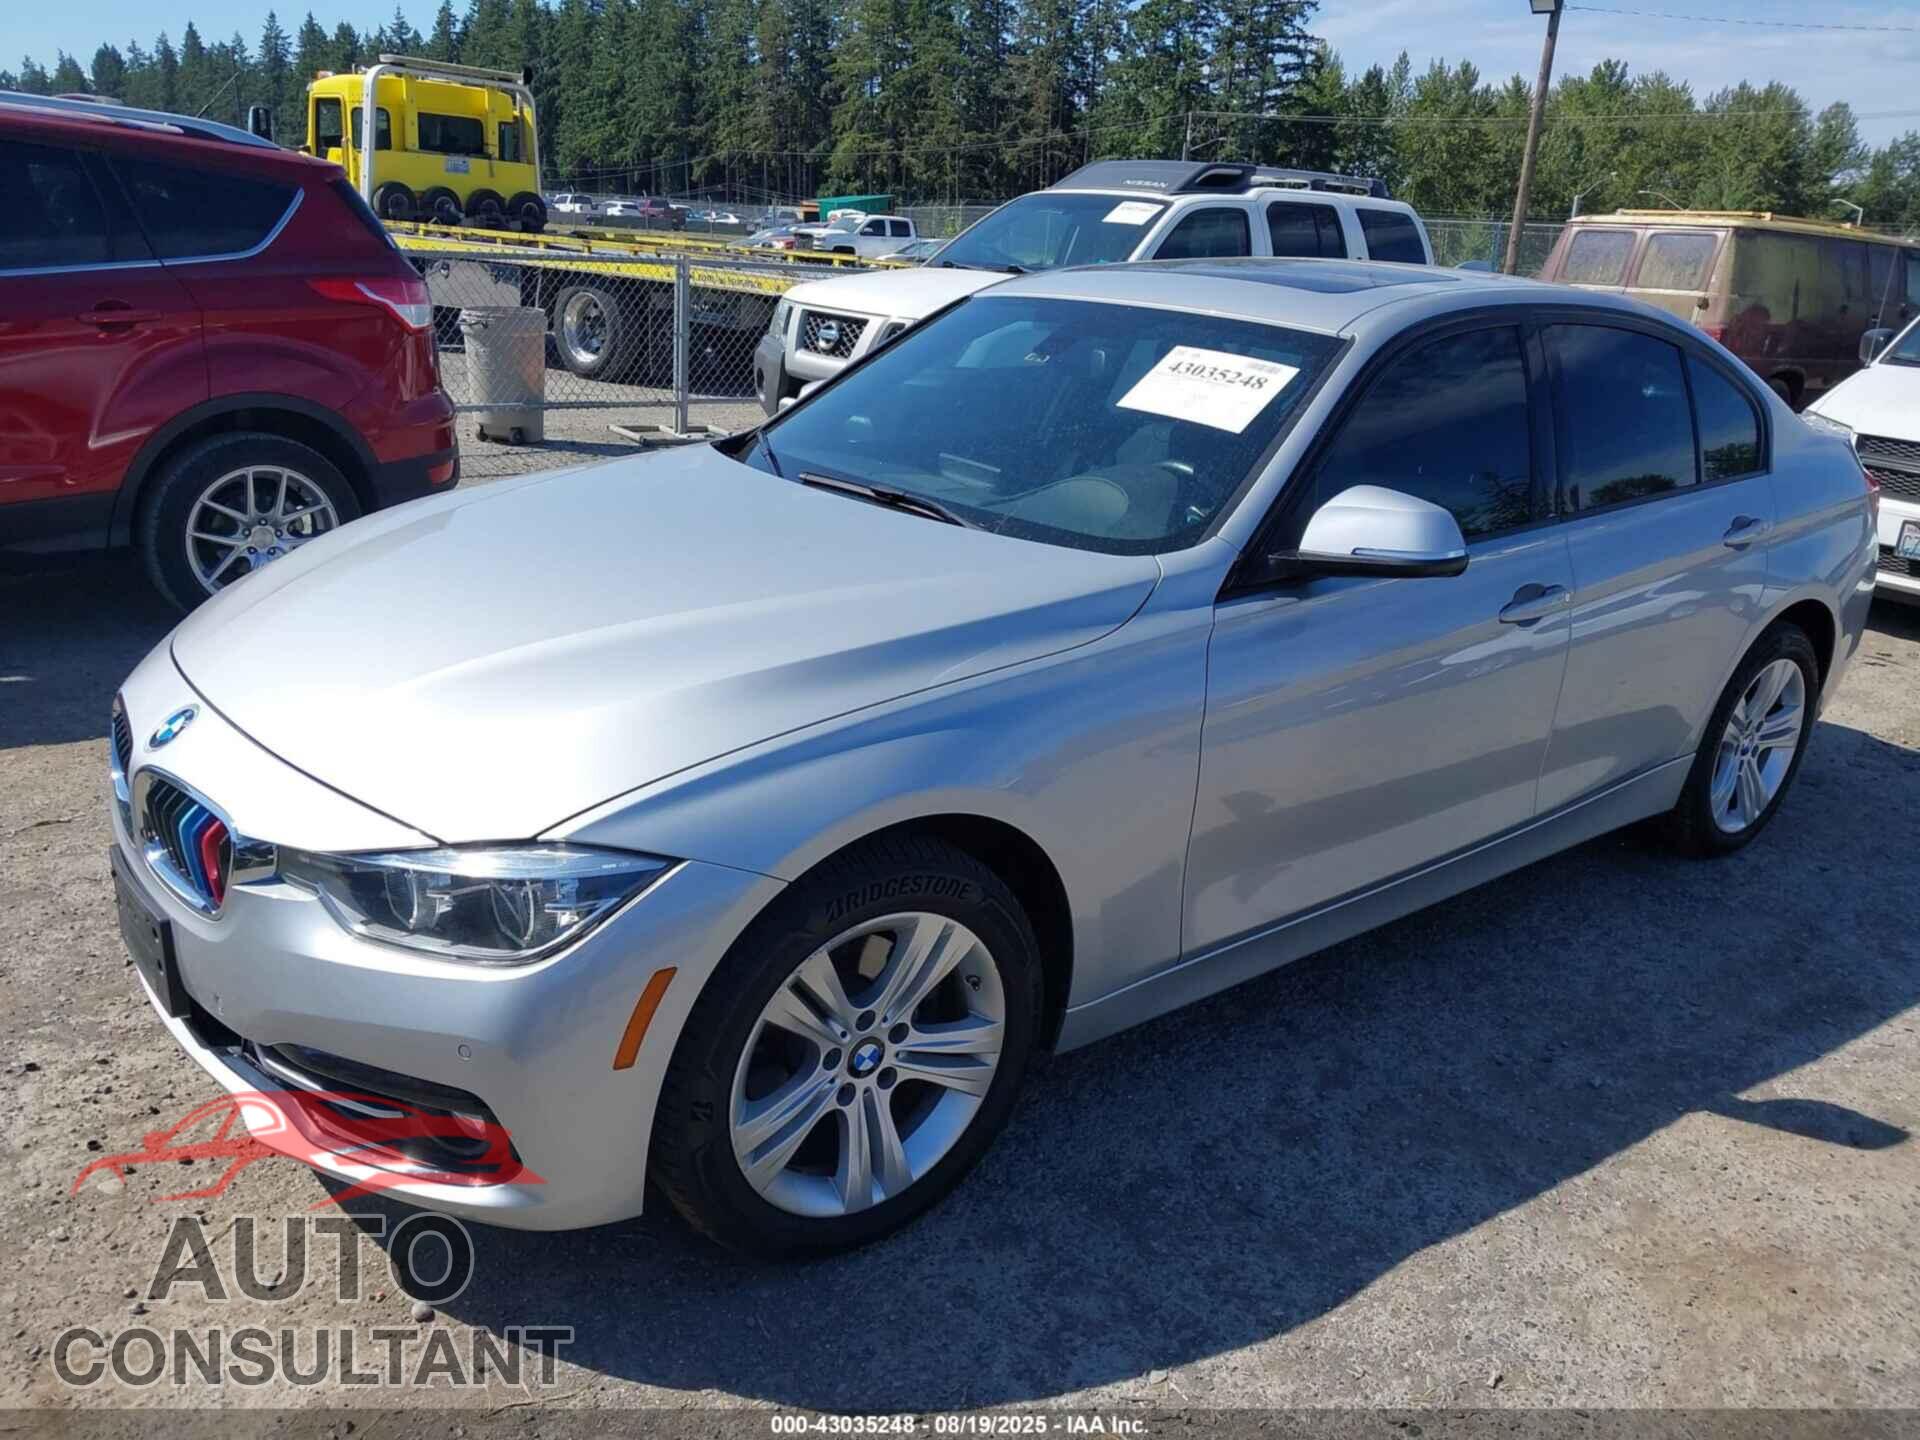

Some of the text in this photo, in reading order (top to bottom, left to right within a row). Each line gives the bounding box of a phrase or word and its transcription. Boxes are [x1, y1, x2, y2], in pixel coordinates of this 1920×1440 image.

[1122, 179, 1169, 189] NISSAN
[1168, 360, 1269, 390] 43035248
[824, 875, 973, 922] BRIDGESTONE
